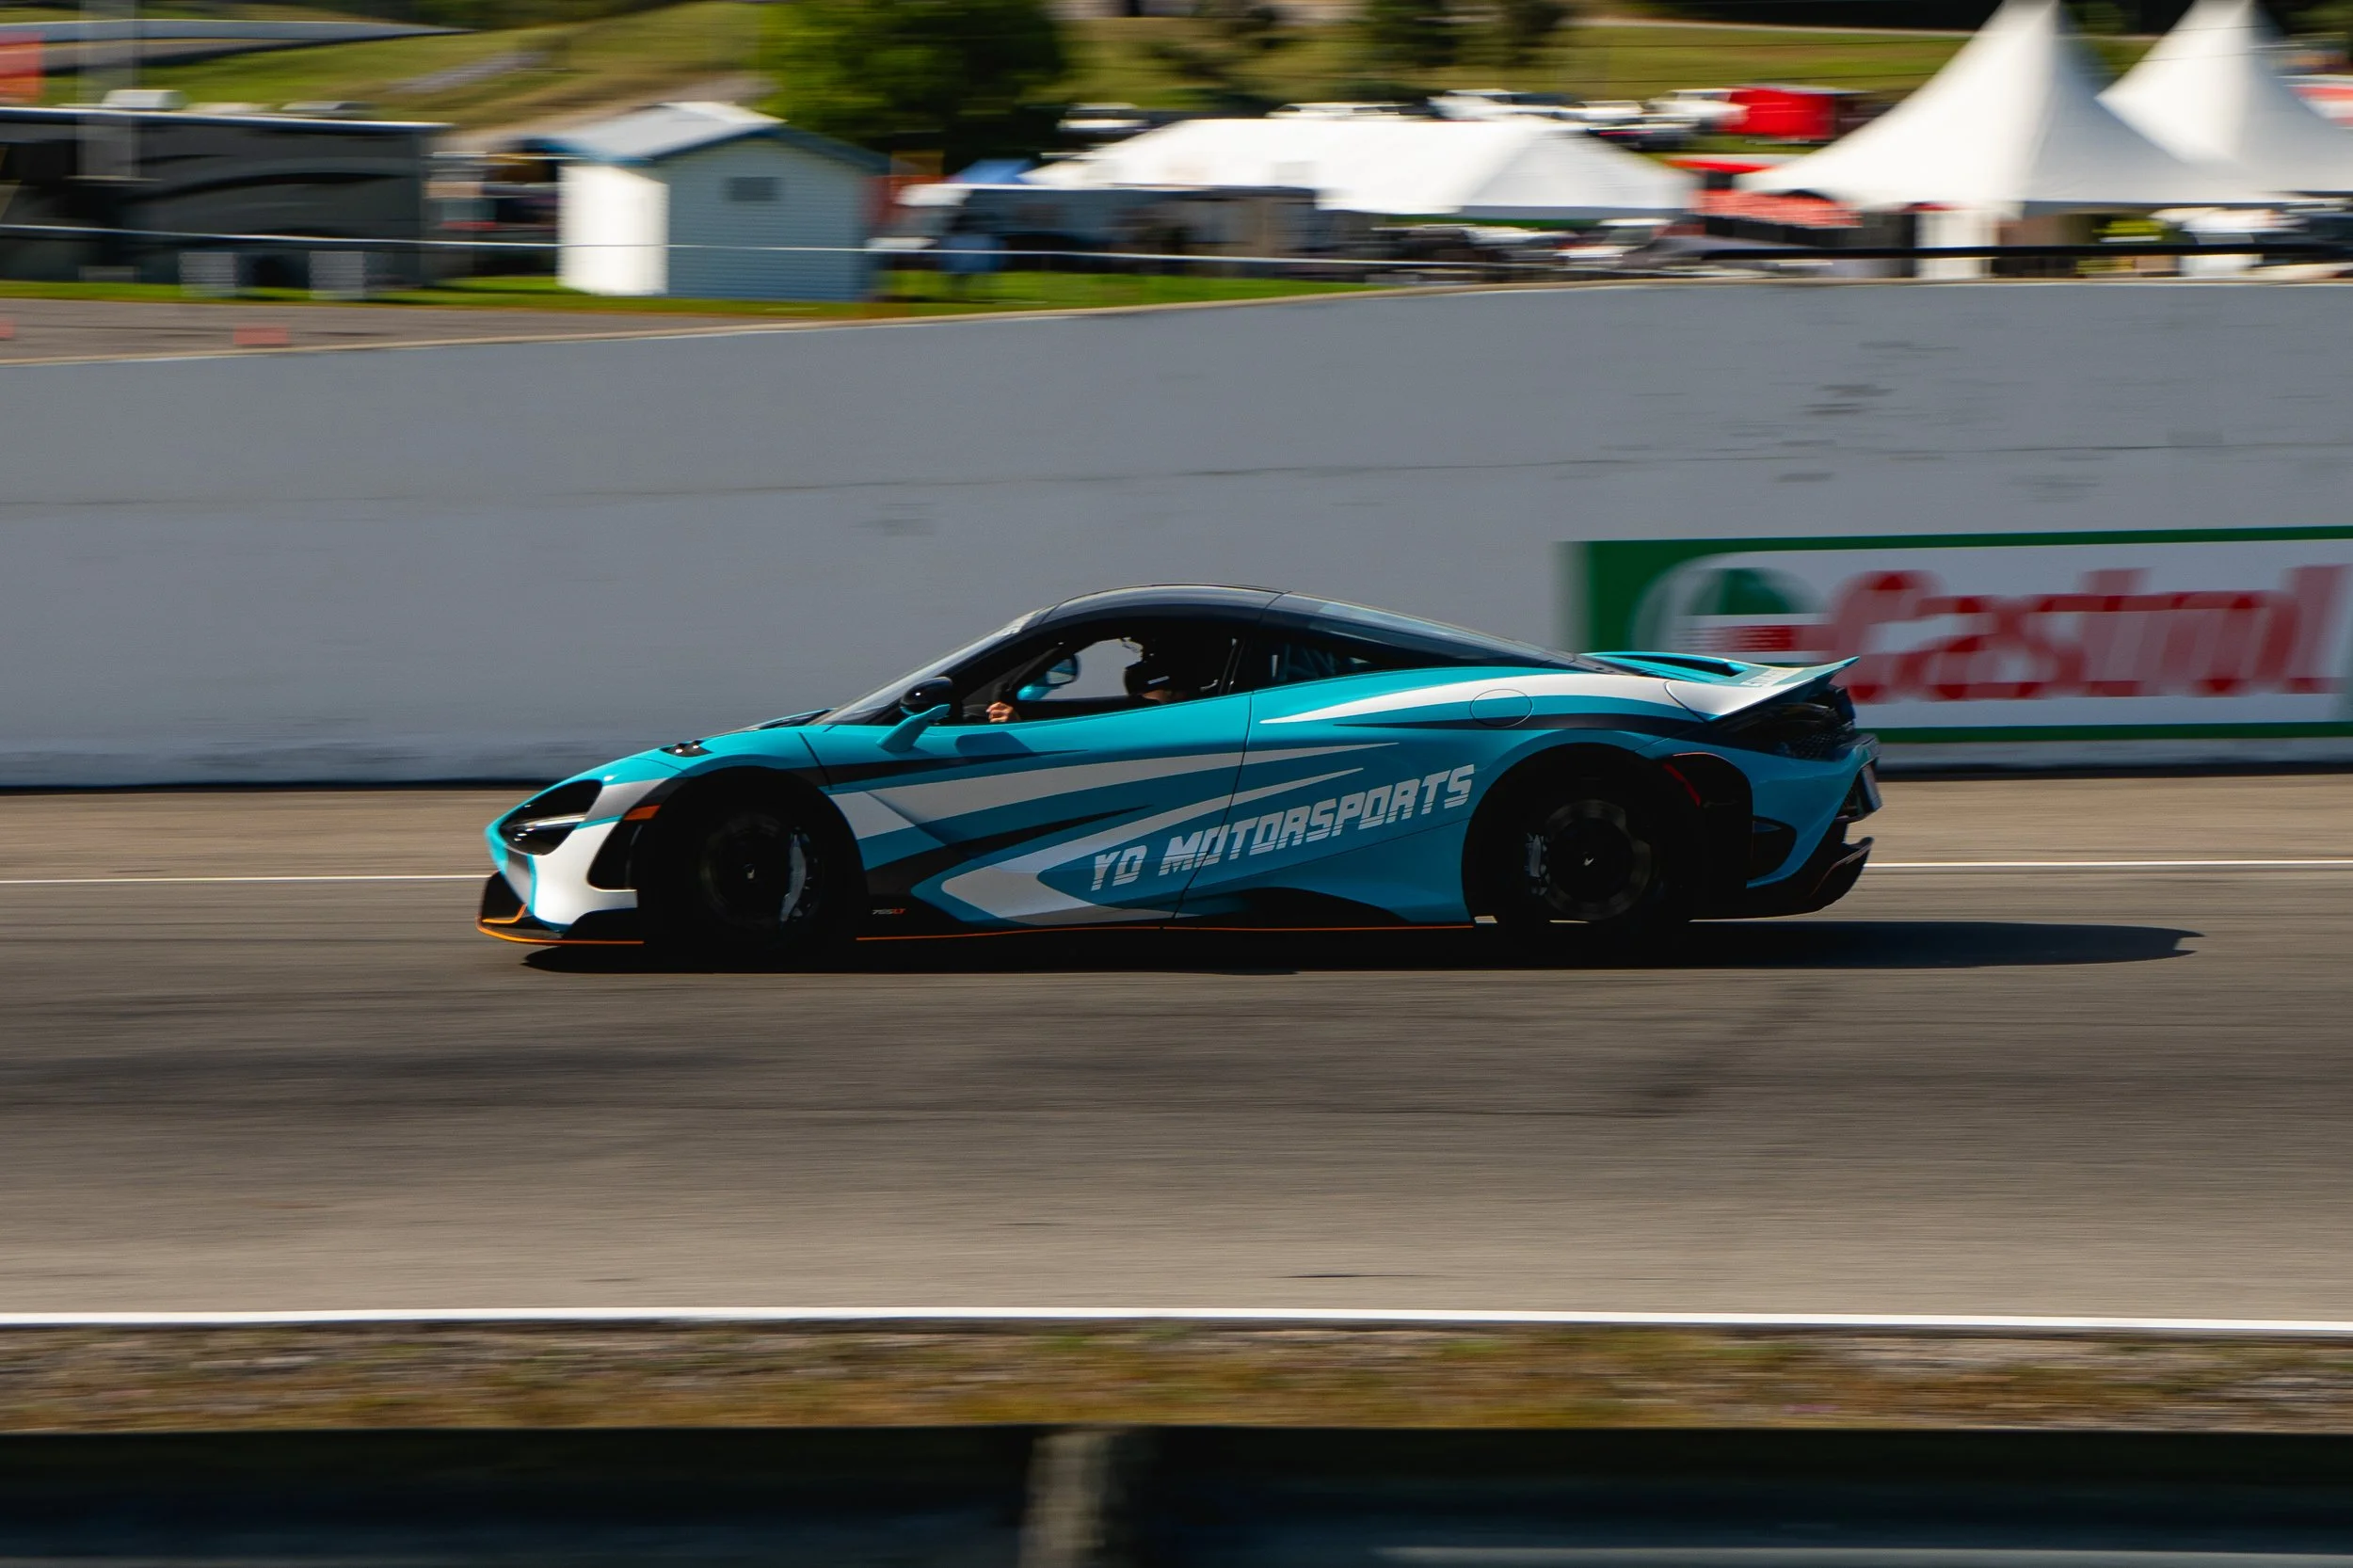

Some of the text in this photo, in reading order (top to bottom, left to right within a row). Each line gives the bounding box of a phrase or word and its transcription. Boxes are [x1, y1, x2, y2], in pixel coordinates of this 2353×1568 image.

[1829, 565, 2345, 704] Castrol
[1091, 763, 1475, 891] YO MOTORSPORTS
